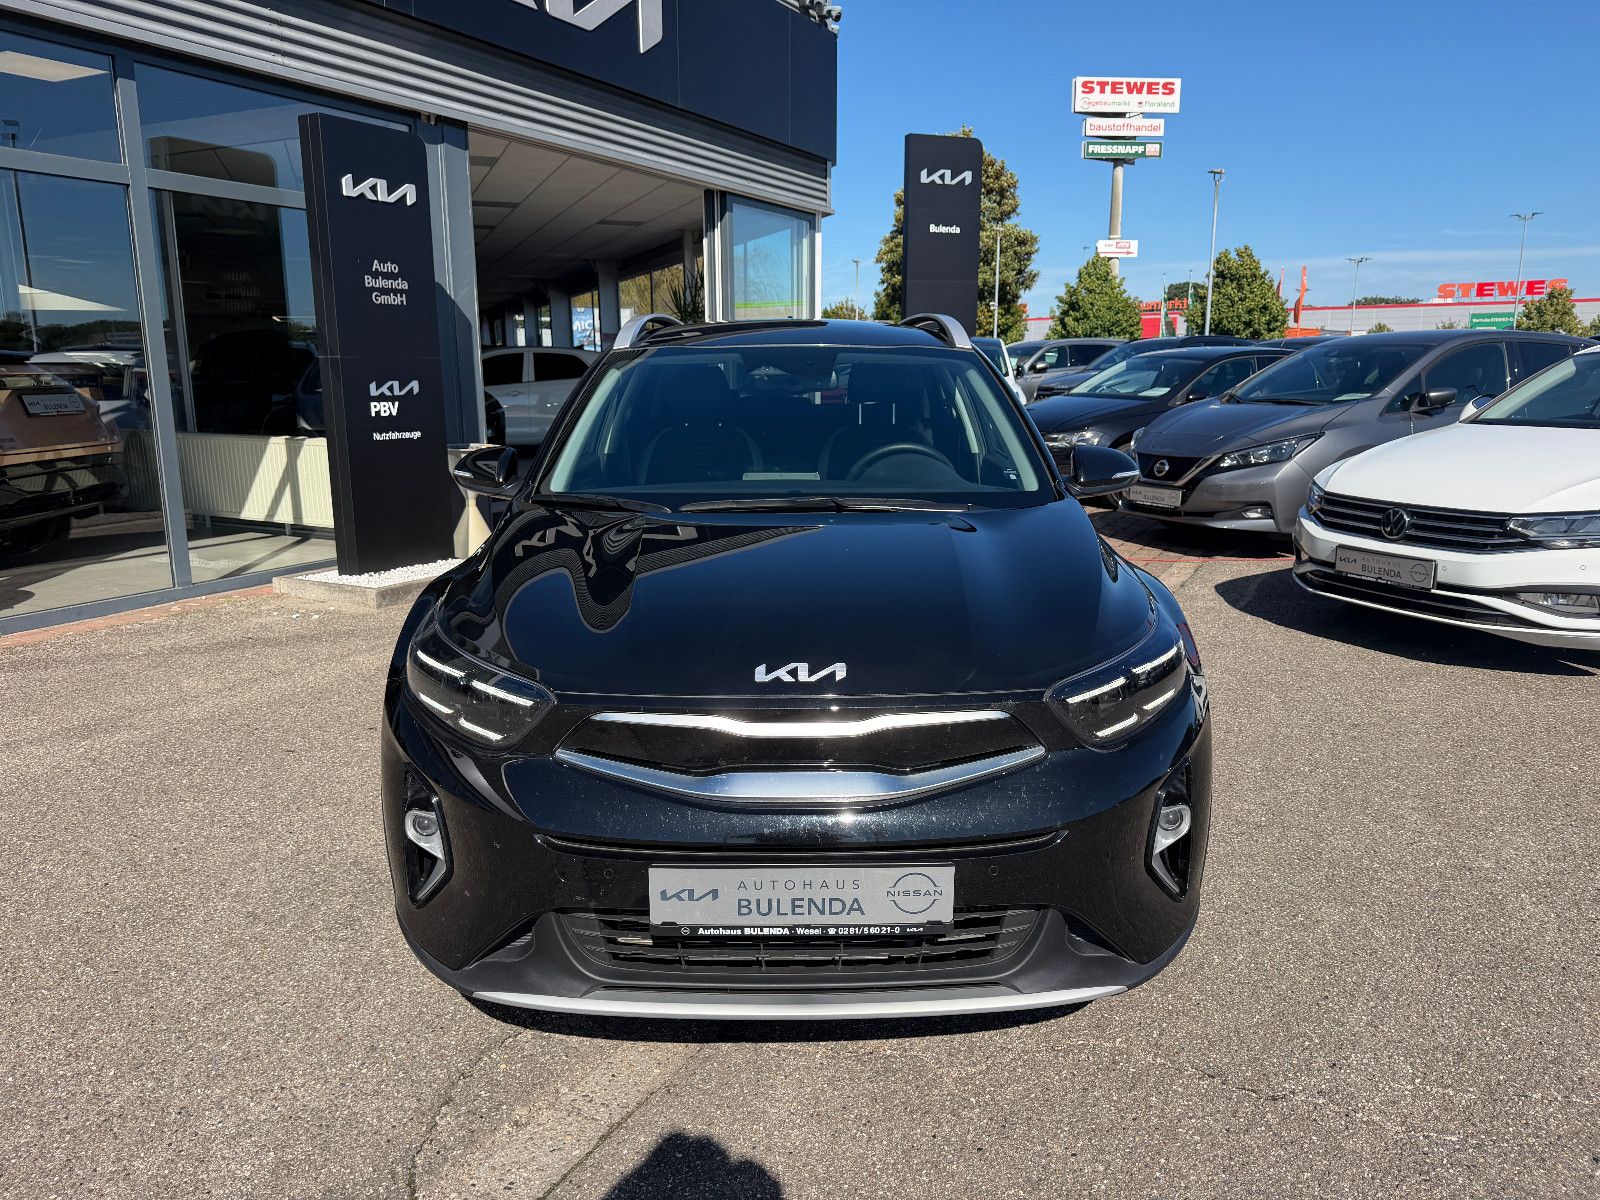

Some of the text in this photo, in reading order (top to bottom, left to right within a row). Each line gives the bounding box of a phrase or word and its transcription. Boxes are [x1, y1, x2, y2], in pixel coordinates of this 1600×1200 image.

[1081, 80, 1175, 96] STEWES
[1144, 100, 1175, 108] floraland
[1089, 123, 1161, 132] baustoffhandel
[1088, 144, 1145, 154] FRESSNAPF
[920, 167, 973, 186] KIA
[341, 173, 417, 206] KIA
[929, 223, 961, 234] Bulenda
[372, 259, 399, 273] Auto
[364, 274, 409, 290] Bulenda
[372, 291, 407, 306] GmbH
[369, 379, 420, 397] KIA
[370, 401, 399, 417] PBV
[373, 430, 422, 441] Nutzfahrzeuge
[1361, 564, 1402, 579] BULENDA
[755, 662, 847, 682] KIA
[737, 879, 861, 891] AUTOHAUS
[659, 887, 719, 902] KIA
[886, 889, 943, 898] NISSAN
[737, 897, 866, 917] BULENDA
[698, 927, 742, 935] Autohaus
[744, 927, 790, 935] BULENDA
[795, 927, 822, 935] Wesel
